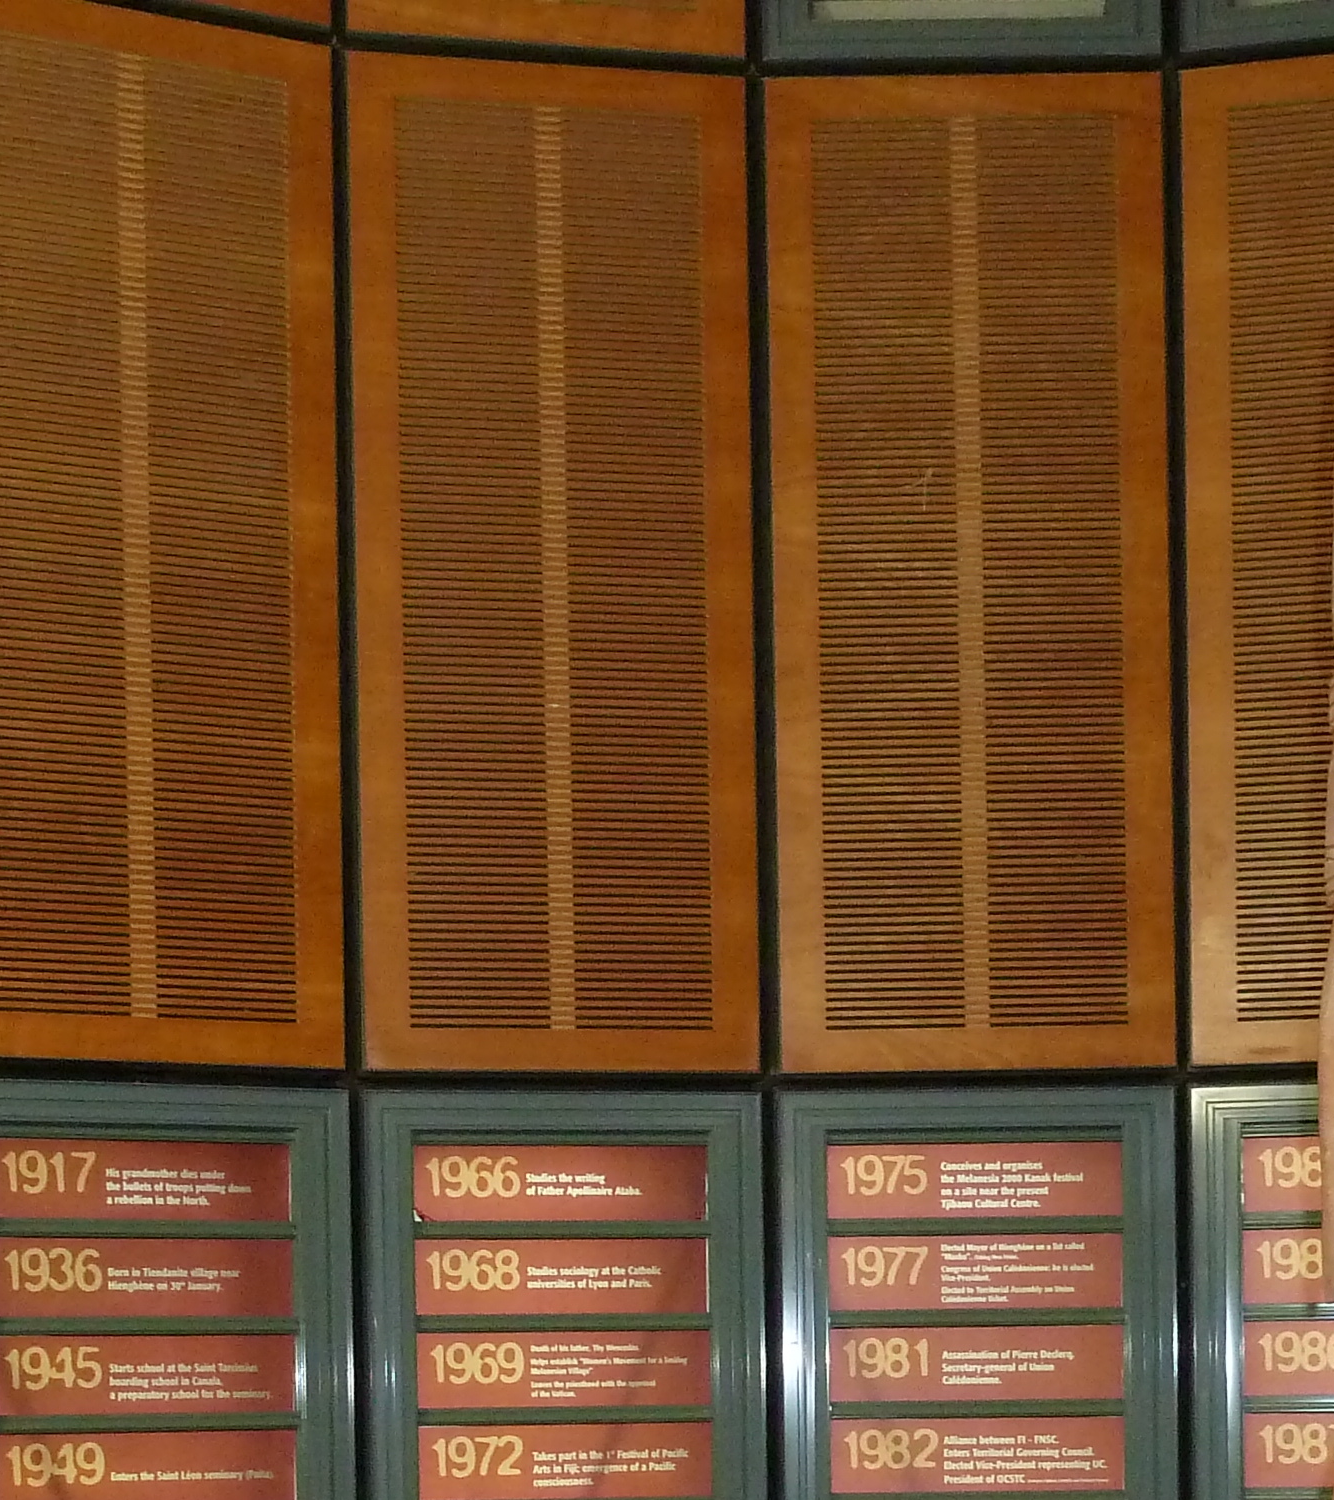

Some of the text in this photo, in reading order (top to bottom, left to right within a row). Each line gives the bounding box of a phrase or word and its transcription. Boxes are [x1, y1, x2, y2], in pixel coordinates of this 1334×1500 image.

[2, 1150, 96, 1194] 1917
[425, 1156, 521, 1198] 1966
[841, 1154, 927, 1195] 1975
[1258, 1147, 1322, 1188] 198
[4, 1247, 101, 1293] 1936
[426, 1249, 520, 1291] 1968
[841, 1246, 928, 1287] 1977
[4, 1346, 102, 1390] 1945
[430, 1342, 524, 1384] 1969
[843, 1338, 929, 1378] 1981
[6, 1442, 105, 1487] 1949
[432, 1435, 523, 1478] 1972
[844, 1428, 939, 1470] 1982
